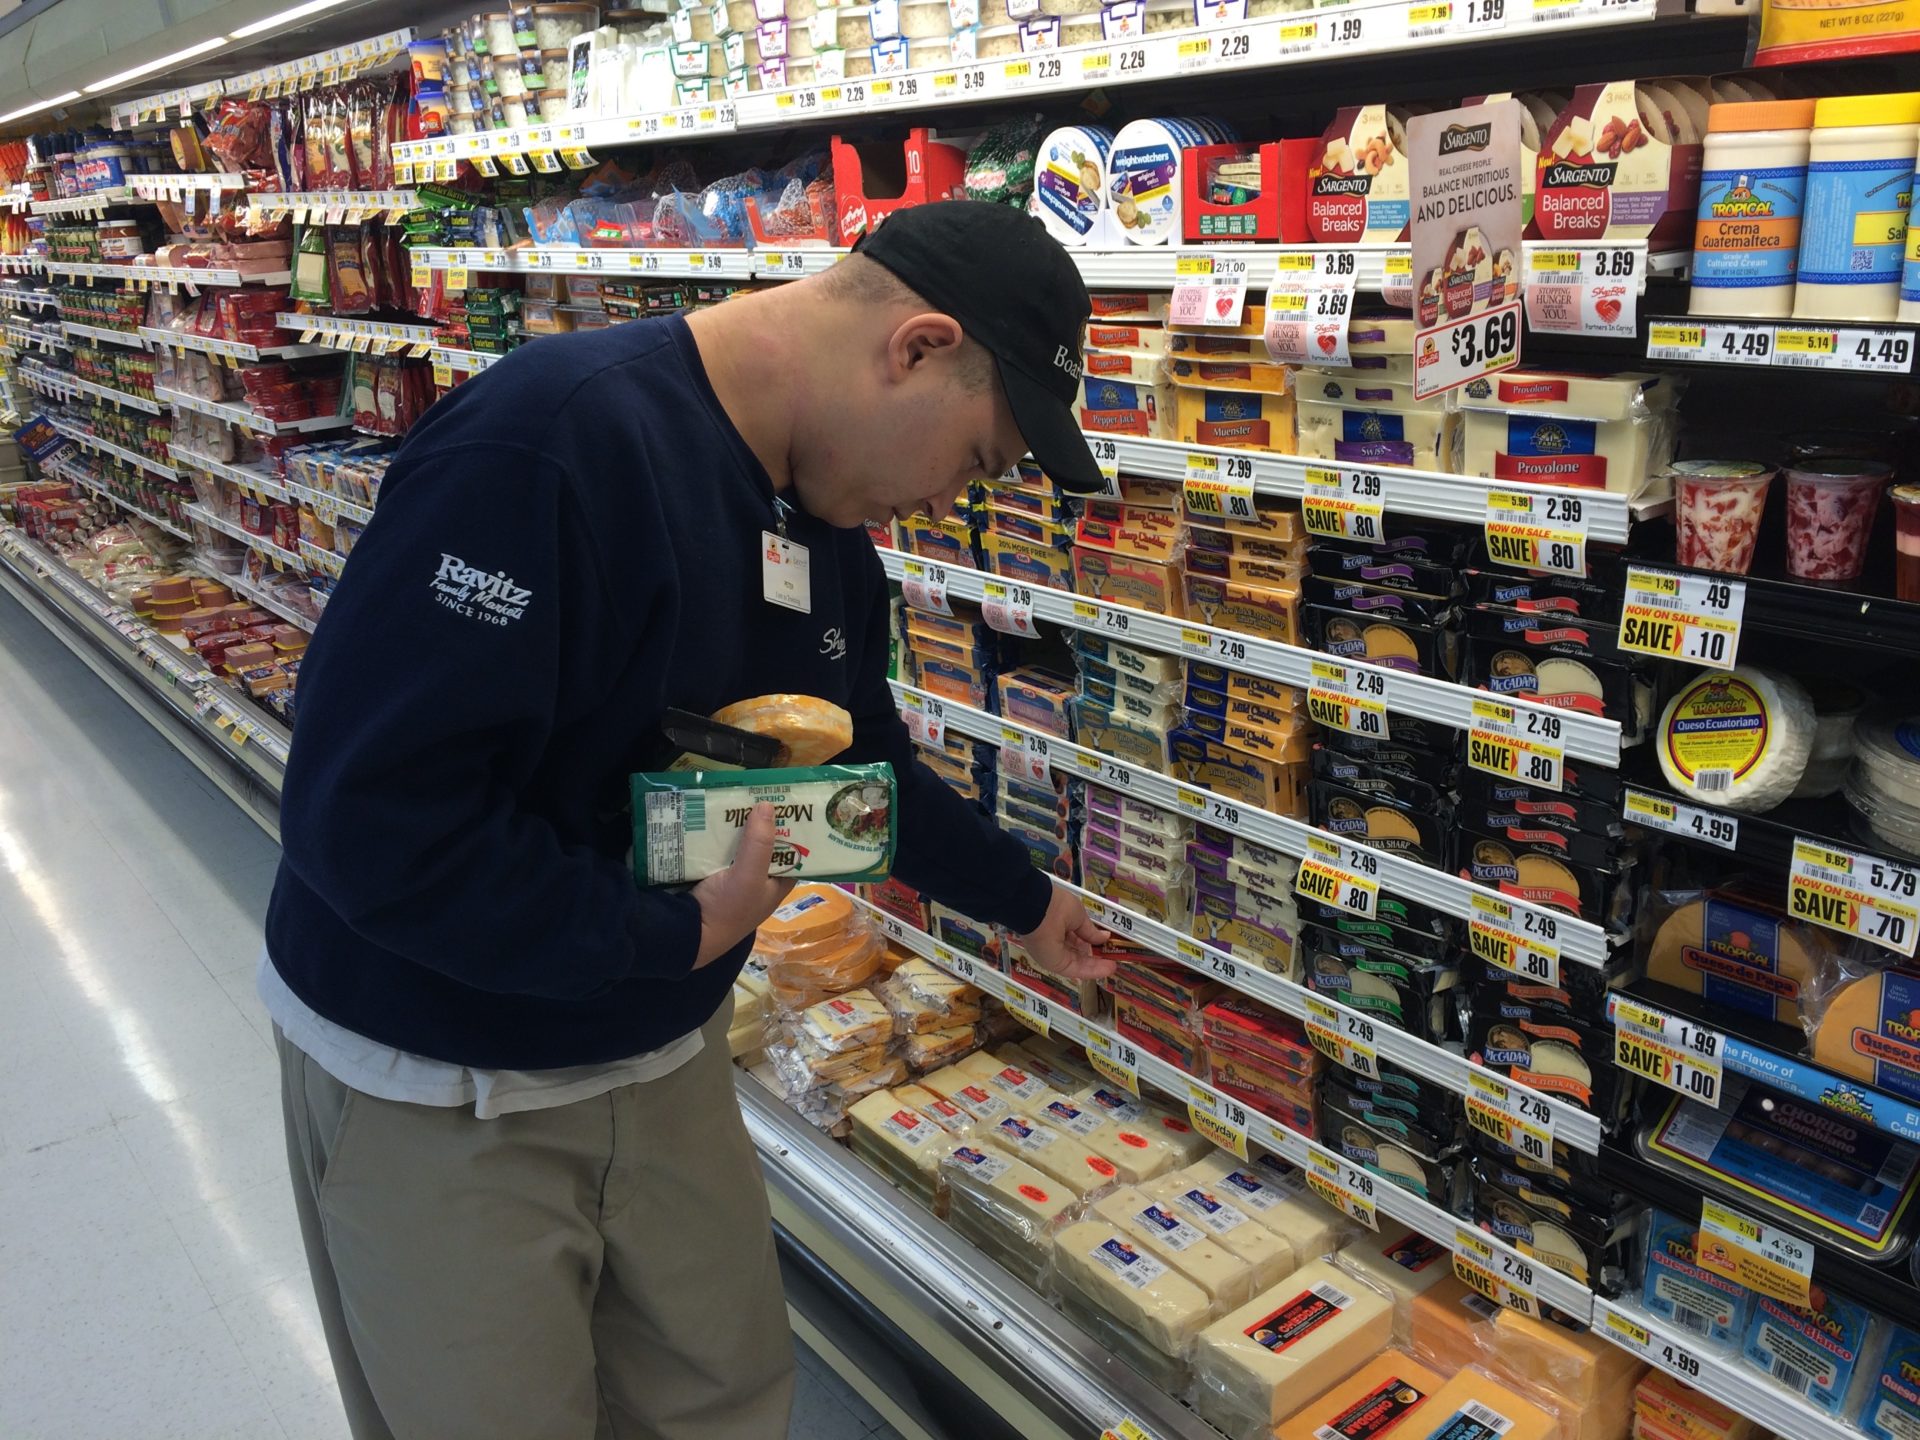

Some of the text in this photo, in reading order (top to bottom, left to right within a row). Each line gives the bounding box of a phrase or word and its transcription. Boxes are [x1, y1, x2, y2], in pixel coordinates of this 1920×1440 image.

[1330, 18, 1362, 42] 1.99
[1819, 10, 1904, 30] NET WT 8 OZ (227g)
[1221, 34, 1250, 58] 2.29
[1038, 60, 1062, 79] 2.29
[1120, 50, 1146, 71] 2.29
[898, 78, 918, 96] 2.99
[964, 70, 985, 90] 3.49
[799, 92, 816, 108] 2.99
[846, 86, 864, 102] 2.29
[1443, 128, 1488, 150] SARGENTO
[907, 150, 921, 174] 10
[1115, 152, 1170, 168] weightwatchers
[1438, 158, 1490, 176] REAL CHEESE PEOPLE
[1316, 178, 1368, 193] SARGENTO
[1423, 167, 1510, 198] BALANCE NUTRITIOUS
[1548, 167, 1611, 184] SARGENTO
[1312, 199, 1363, 216] Balanced
[1416, 202, 1445, 224] AND
[1448, 184, 1517, 216] DELICIOUS.
[1542, 192, 1604, 212] Balanced
[1712, 200, 1774, 218] TROPICAL
[1322, 216, 1360, 233] Breaks
[1553, 212, 1601, 230] Breaks
[1718, 222, 1760, 235] Crema
[1702, 234, 1780, 248] Guatemalteca
[540, 255, 552, 267] 3.79
[591, 256, 602, 268] 3.79
[645, 256, 658, 268] 3.79
[708, 256, 722, 269] 5.49
[787, 255, 803, 269] 5.49
[1216, 262, 1246, 273] 2/1.00
[1326, 253, 1354, 275] 3.69
[1595, 251, 1635, 276] 3.69
[1706, 258, 1768, 268] Cultured Cream
[1536, 294, 1572, 305] HUNGER
[1538, 287, 1571, 295] STOPPING
[1317, 294, 1348, 316] 3.69
[1542, 308, 1568, 320] YOU!
[1585, 323, 1634, 333] Partners In Caring
[1679, 330, 1699, 343] 5.14
[1452, 310, 1517, 368] $3.69
[1721, 332, 1770, 356] 4.49
[1856, 338, 1909, 364] 4.49
[1512, 383, 1553, 395] Provolone
[1092, 414, 1135, 426] Pepper Jack
[1213, 426, 1251, 437] Muenster
[1360, 444, 1385, 456] Swiss
[1227, 458, 1252, 479] 2.99
[1517, 460, 1580, 475] Provolone
[1352, 474, 1381, 496] 2.99
[1546, 498, 1582, 522] 2.99
[1305, 508, 1375, 538] SAVE .80
[1487, 523, 1552, 538] NOW ON SALE
[1489, 535, 1574, 569] SAVE .80
[434, 552, 533, 606] Ravitz
[929, 567, 946, 585] 3.49
[428, 576, 526, 620] Family Markets
[1012, 587, 1031, 607] 3.49
[1700, 584, 1731, 610] .49
[434, 592, 509, 626] SINCE 1968
[1623, 617, 1726, 661] SAVE .10
[1356, 672, 1385, 696] 2.49
[1491, 675, 1537, 694] McCADAM
[927, 700, 943, 718] 3.49
[1543, 696, 1576, 708] SHARP
[1692, 699, 1746, 716] TROPICAL
[1310, 698, 1380, 734] SAVE .80
[1528, 712, 1562, 740] 2.49
[1677, 716, 1760, 732] Queso Ecuatoriano
[1471, 739, 1552, 783] SAVE .80
[1690, 815, 1735, 843] 4.99
[1350, 850, 1378, 875] 2.49
[1825, 852, 1847, 868] 6.62
[1472, 864, 1518, 881] McCADAM
[1870, 863, 1917, 897] 5.79
[1792, 875, 1877, 906] NOW ON SALE
[1524, 912, 1557, 940] 2.49
[1793, 888, 1848, 926] SAVE
[1868, 911, 1906, 945] .70
[887, 920, 903, 937] 2.99
[1472, 930, 1549, 979] SAVE .80
[1710, 939, 1770, 967] TROPICAL
[957, 958, 974, 976] 3.49
[1688, 950, 1734, 972] Queso
[1734, 963, 1754, 979] de
[1754, 969, 1794, 994] Papa
[1122, 1014, 1152, 1034] Borden
[1348, 1017, 1374, 1042] 2.49
[1641, 1013, 1660, 1028] 3.98
[1618, 1030, 1686, 1062] NOW ON SALE
[1680, 1026, 1717, 1057] 1.99
[1858, 1033, 1909, 1060] Queso
[1118, 1045, 1136, 1066] 1.99
[1724, 1040, 1738, 1057] he
[1740, 1050, 1779, 1072] Flavor
[1781, 1063, 1794, 1078] of
[1092, 1052, 1130, 1082] Everyday
[1619, 1040, 1663, 1078] SAVE
[1674, 1064, 1716, 1099] 1.00
[1217, 1072, 1256, 1092] Borden
[1224, 1103, 1246, 1126] 1.99
[1519, 1096, 1551, 1125] 2.49
[1194, 1110, 1237, 1143] Everyday
[1770, 1109, 1856, 1154] Colombiano
[1780, 1102, 1858, 1141] CHORIZO
[1348, 1170, 1374, 1196] 2.49
[1738, 1222, 1755, 1238] 5.70
[1107, 1241, 1132, 1261] Swiss
[1771, 1239, 1803, 1260] 4.99
[1651, 1251, 1696, 1278] Queso
[1696, 1266, 1747, 1299] Blanco
[1277, 1300, 1328, 1333] CHEDDAR
[1759, 1297, 1803, 1336] Queso
[1803, 1324, 1854, 1366] Blanco
[1662, 1345, 1700, 1377] 4.99
